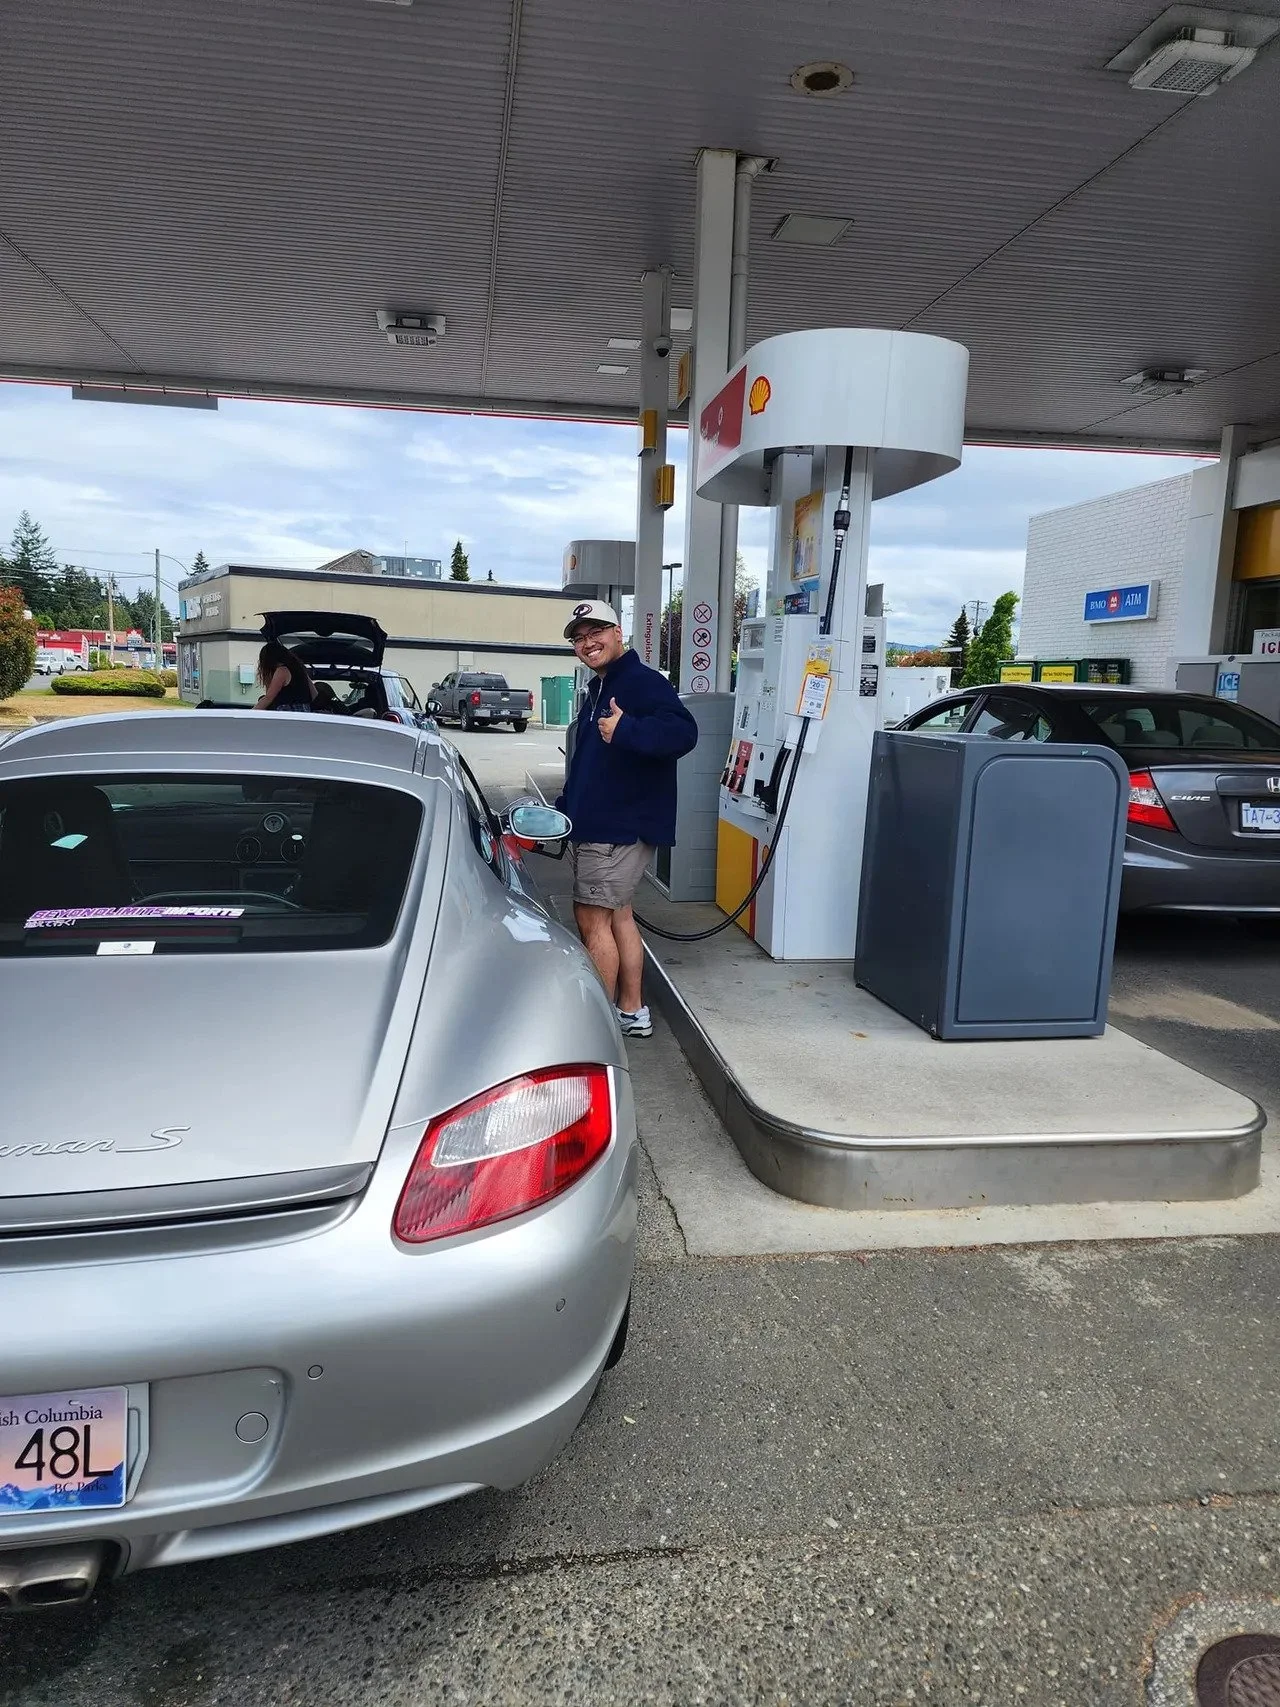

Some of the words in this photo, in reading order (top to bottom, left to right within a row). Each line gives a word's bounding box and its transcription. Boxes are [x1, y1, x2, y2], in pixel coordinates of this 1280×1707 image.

[1090, 600, 1106, 610] BMO
[1125, 593, 1142, 606] ATM
[644, 613, 654, 663] Extinguisher
[1219, 673, 1240, 690] ICE
[116, 1125, 191, 1153] S
[24, 1405, 104, 1425] Columbia
[14, 1424, 114, 1482] 48L
[54, 1482, 74, 1494] BC
[77, 1480, 108, 1492] Parks
